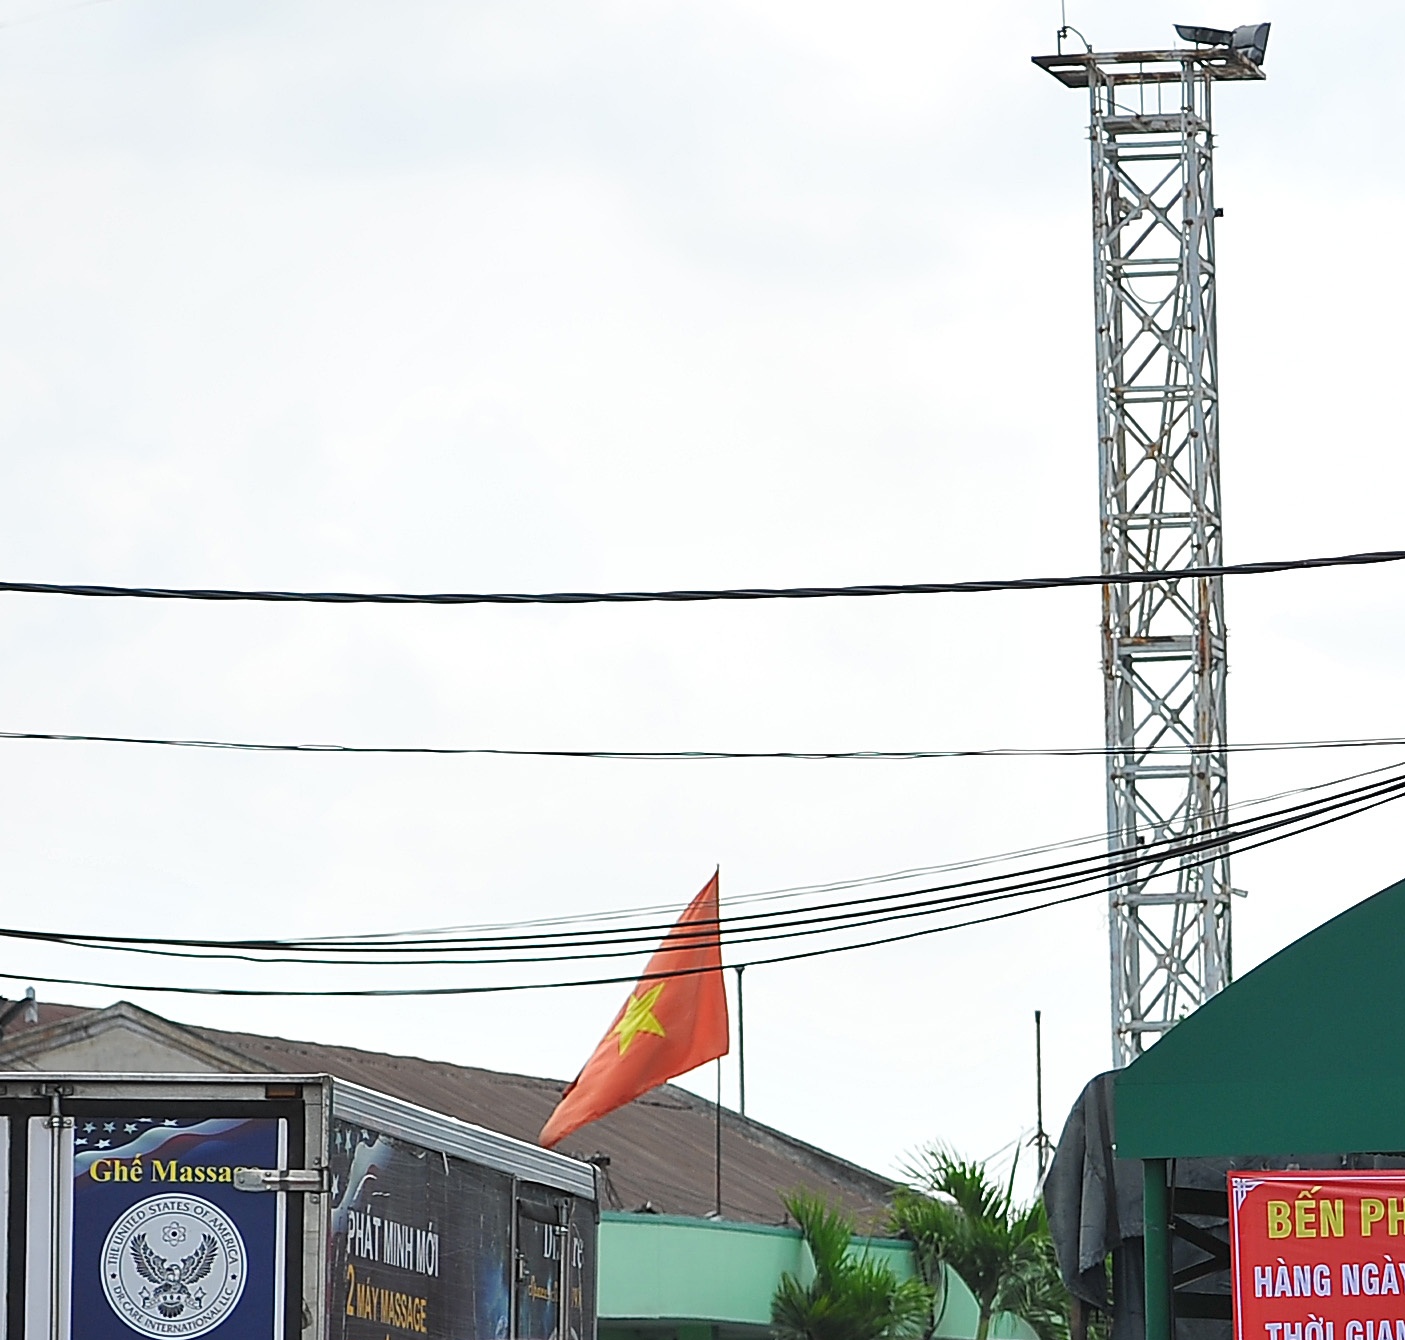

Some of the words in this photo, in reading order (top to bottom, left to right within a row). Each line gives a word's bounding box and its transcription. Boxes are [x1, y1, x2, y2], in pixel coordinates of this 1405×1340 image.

[89, 1153, 143, 1182] Ghế
[151, 1159, 259, 1183] Massa
[107, 1248, 120, 1265] THE
[116, 1210, 146, 1245] UNITED
[149, 1201, 190, 1216] STATES
[193, 1205, 211, 1219] OF
[209, 1217, 239, 1265] AMERICA
[1267, 1186, 1345, 1239] BẾN
[346, 1205, 381, 1261] PHÁT
[384, 1220, 413, 1271] MINH
[416, 1222, 439, 1277] MỚI
[346, 1263, 356, 1316] 2
[357, 1277, 378, 1321] MÁY
[380, 1289, 428, 1333] MASSAGE
[1254, 1257, 1330, 1298] HÀNG
[143, 1306, 223, 1334] INTERNATIONAL
[217, 1287, 234, 1309] LLC
